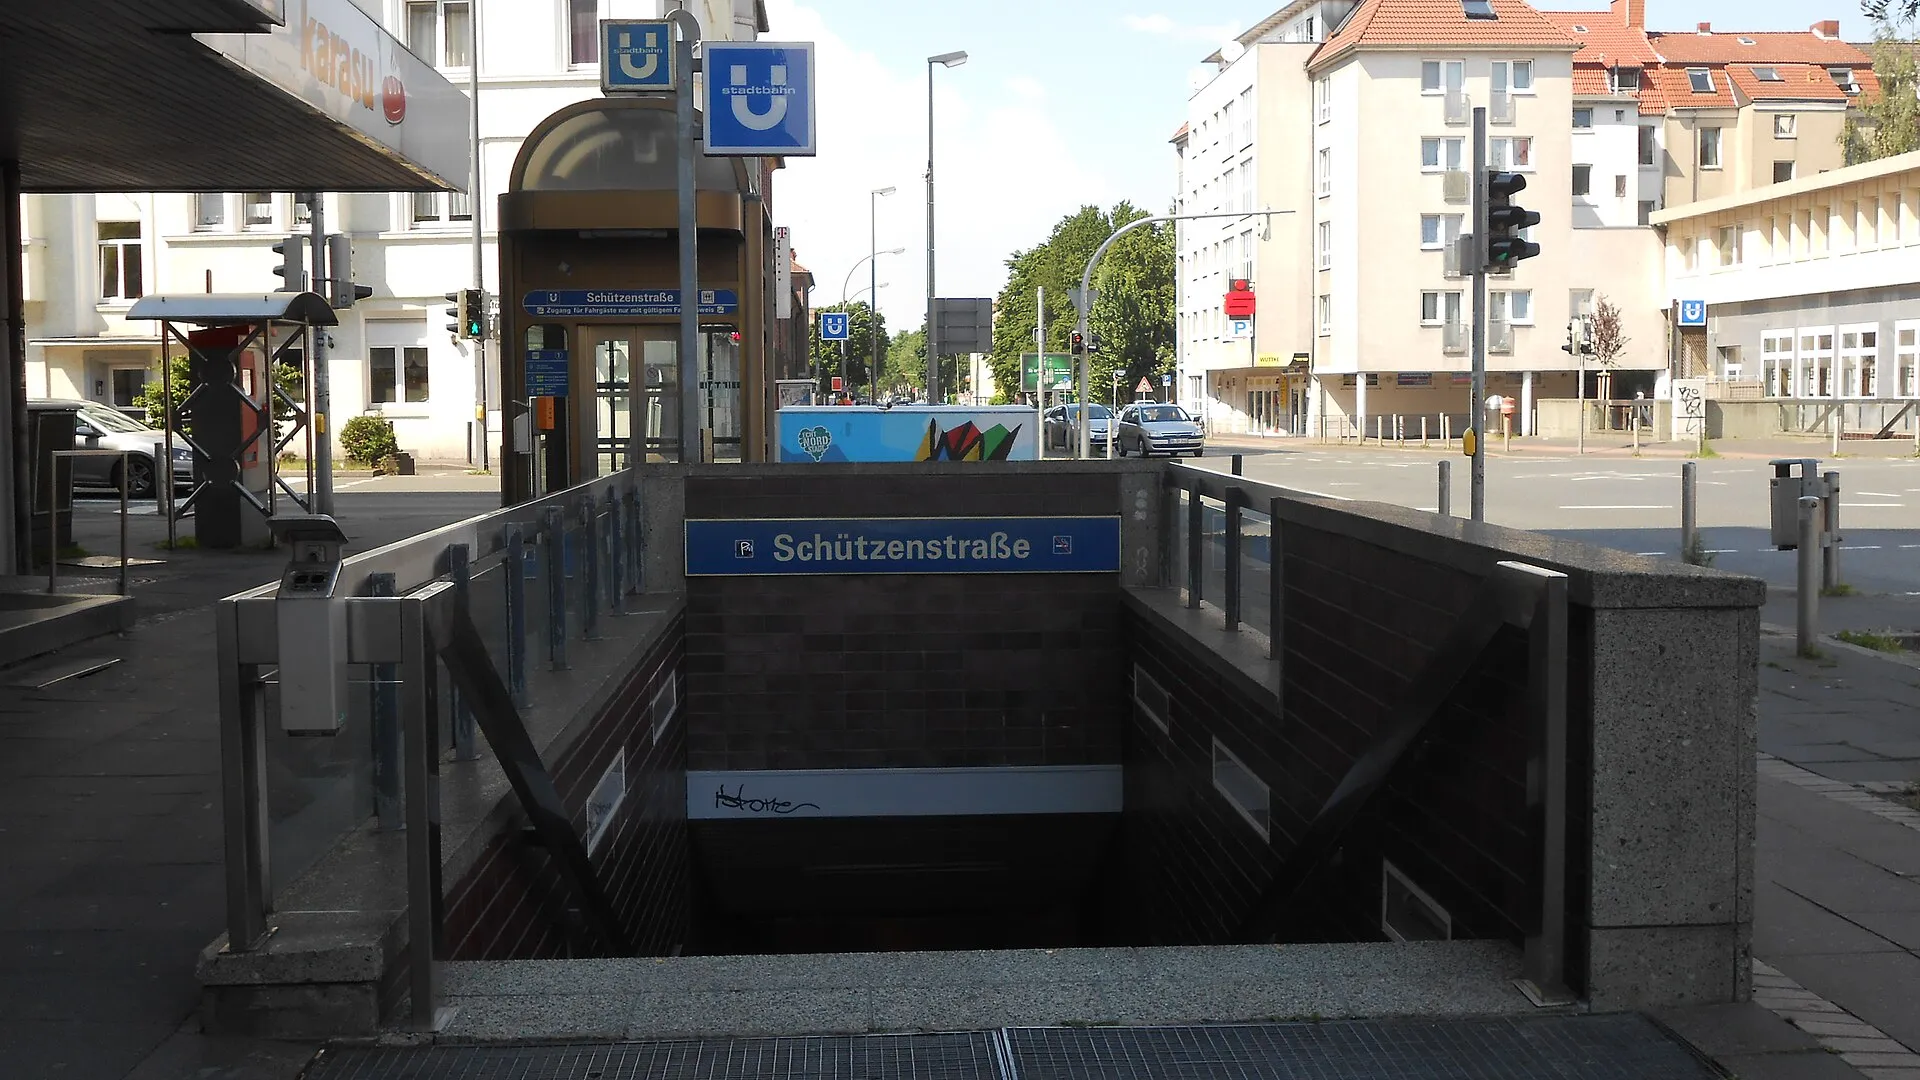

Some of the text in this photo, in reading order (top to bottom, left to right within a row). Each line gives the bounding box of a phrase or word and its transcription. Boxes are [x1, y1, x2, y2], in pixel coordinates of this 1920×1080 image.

[300, 0, 374, 111] karasu
[614, 46, 663, 54] stadtbahn
[722, 85, 796, 95] stadtbahn
[586, 292, 674, 303] Schützenstraße
[546, 307, 571, 315] Zugang
[585, 307, 617, 315] Fahrgäste
[643, 307, 672, 315] gültigem
[1234, 321, 1246, 334] P
[803, 436, 829, 447] NORD
[773, 531, 1031, 562] Schützenstraße
